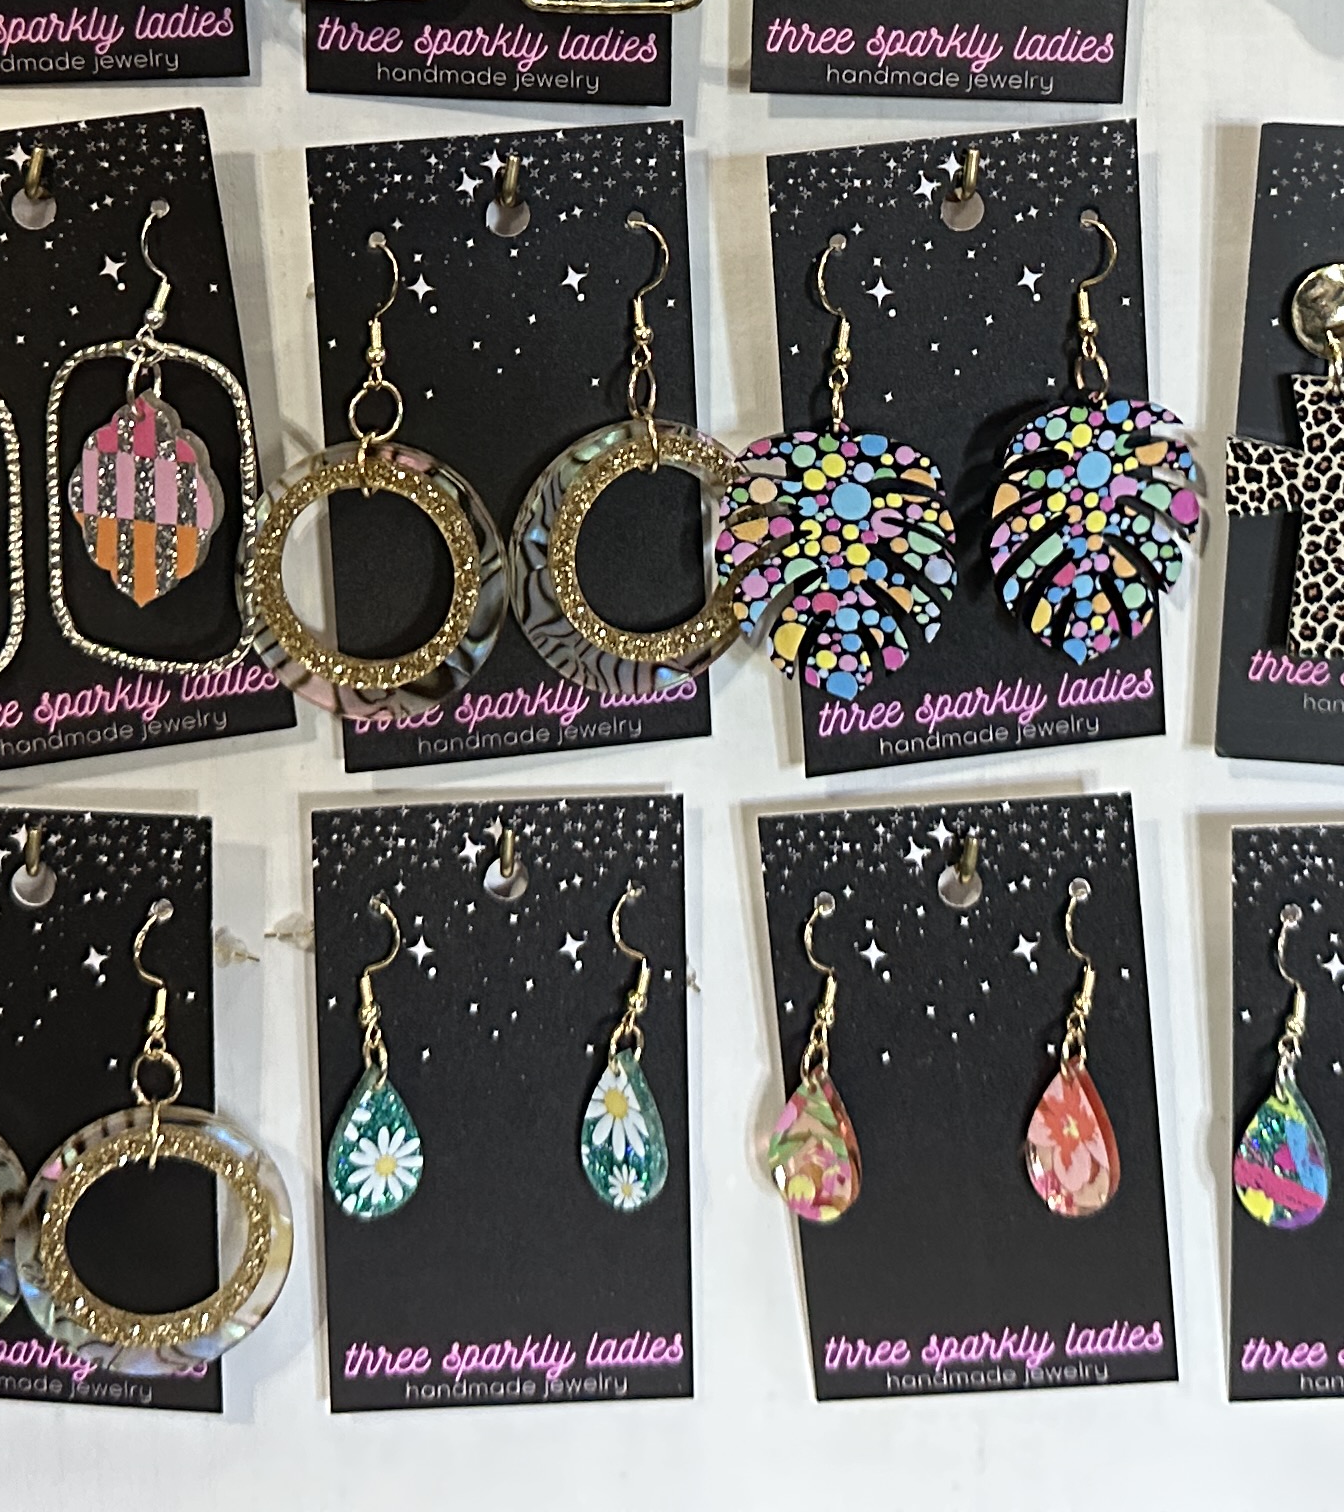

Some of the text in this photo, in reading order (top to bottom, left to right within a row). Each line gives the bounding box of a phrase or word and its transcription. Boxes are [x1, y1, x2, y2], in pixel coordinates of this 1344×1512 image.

[135, 3, 234, 40] ladies
[93, 48, 179, 74] jewelry
[317, 16, 657, 72] three sparkly ladies
[766, 17, 1115, 72] three sparkly ladies
[377, 62, 599, 95] handmade jewelry
[827, 63, 1054, 95] handmade jewelry
[1248, 649, 1331, 687] three
[33, 675, 170, 734] sparkly
[455, 679, 589, 734] sparkly
[818, 667, 1155, 738] three sparkly ladies
[0, 708, 229, 757] handmade jewelry
[418, 715, 643, 756] handmade jewelry
[879, 713, 1100, 756] handmade jewelry
[344, 1330, 684, 1382] three sparkly ladies
[824, 1319, 1164, 1373] three sparkly ladies
[1242, 1337, 1327, 1373] three
[69, 1378, 153, 1403] jewelry
[406, 1372, 628, 1401] handmade jewelry
[887, 1360, 1109, 1391] handmade jewelry
